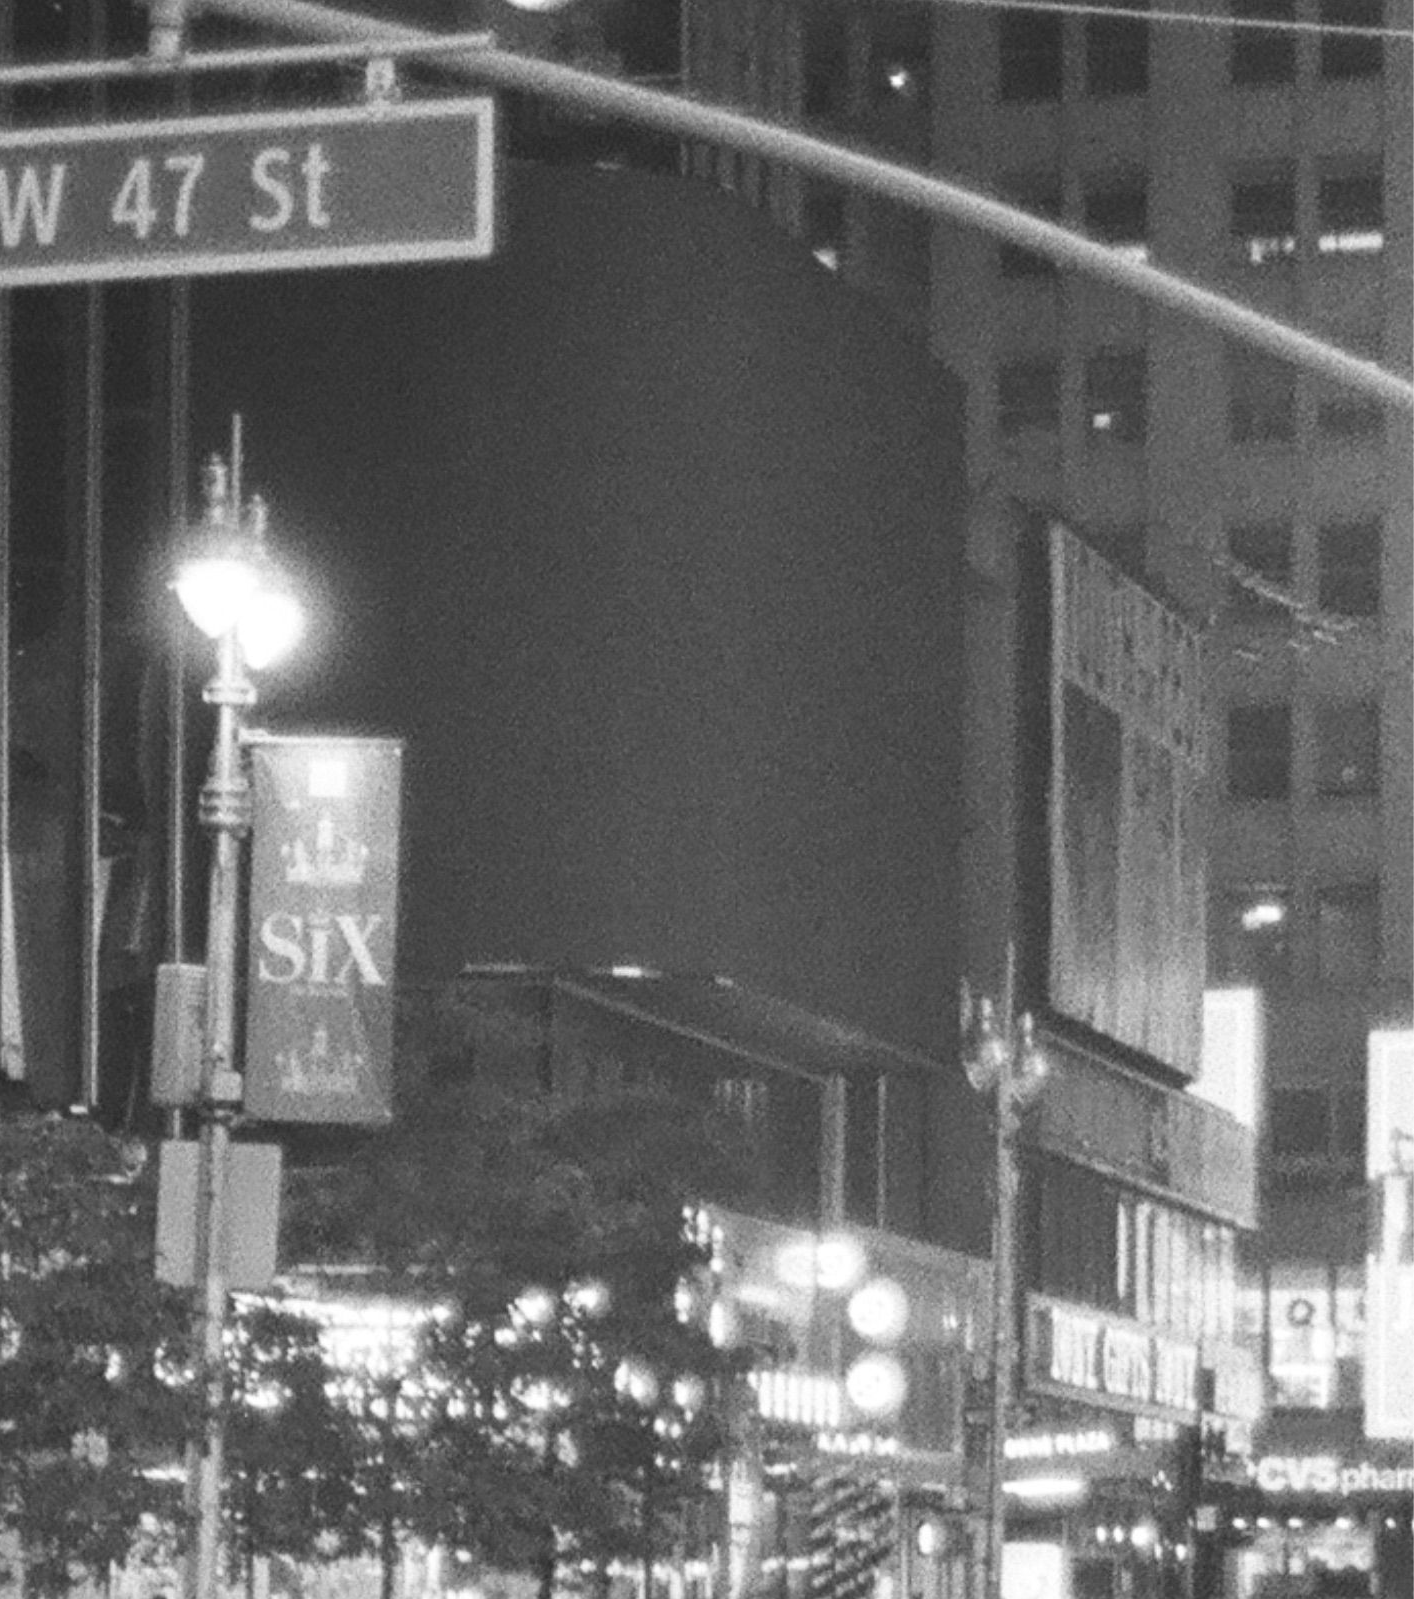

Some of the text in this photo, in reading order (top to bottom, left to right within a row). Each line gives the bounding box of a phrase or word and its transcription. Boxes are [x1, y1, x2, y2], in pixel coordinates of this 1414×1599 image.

[111, 153, 206, 239] 47
[249, 142, 331, 233] St
[1256, 1455, 1338, 1493] CVS
